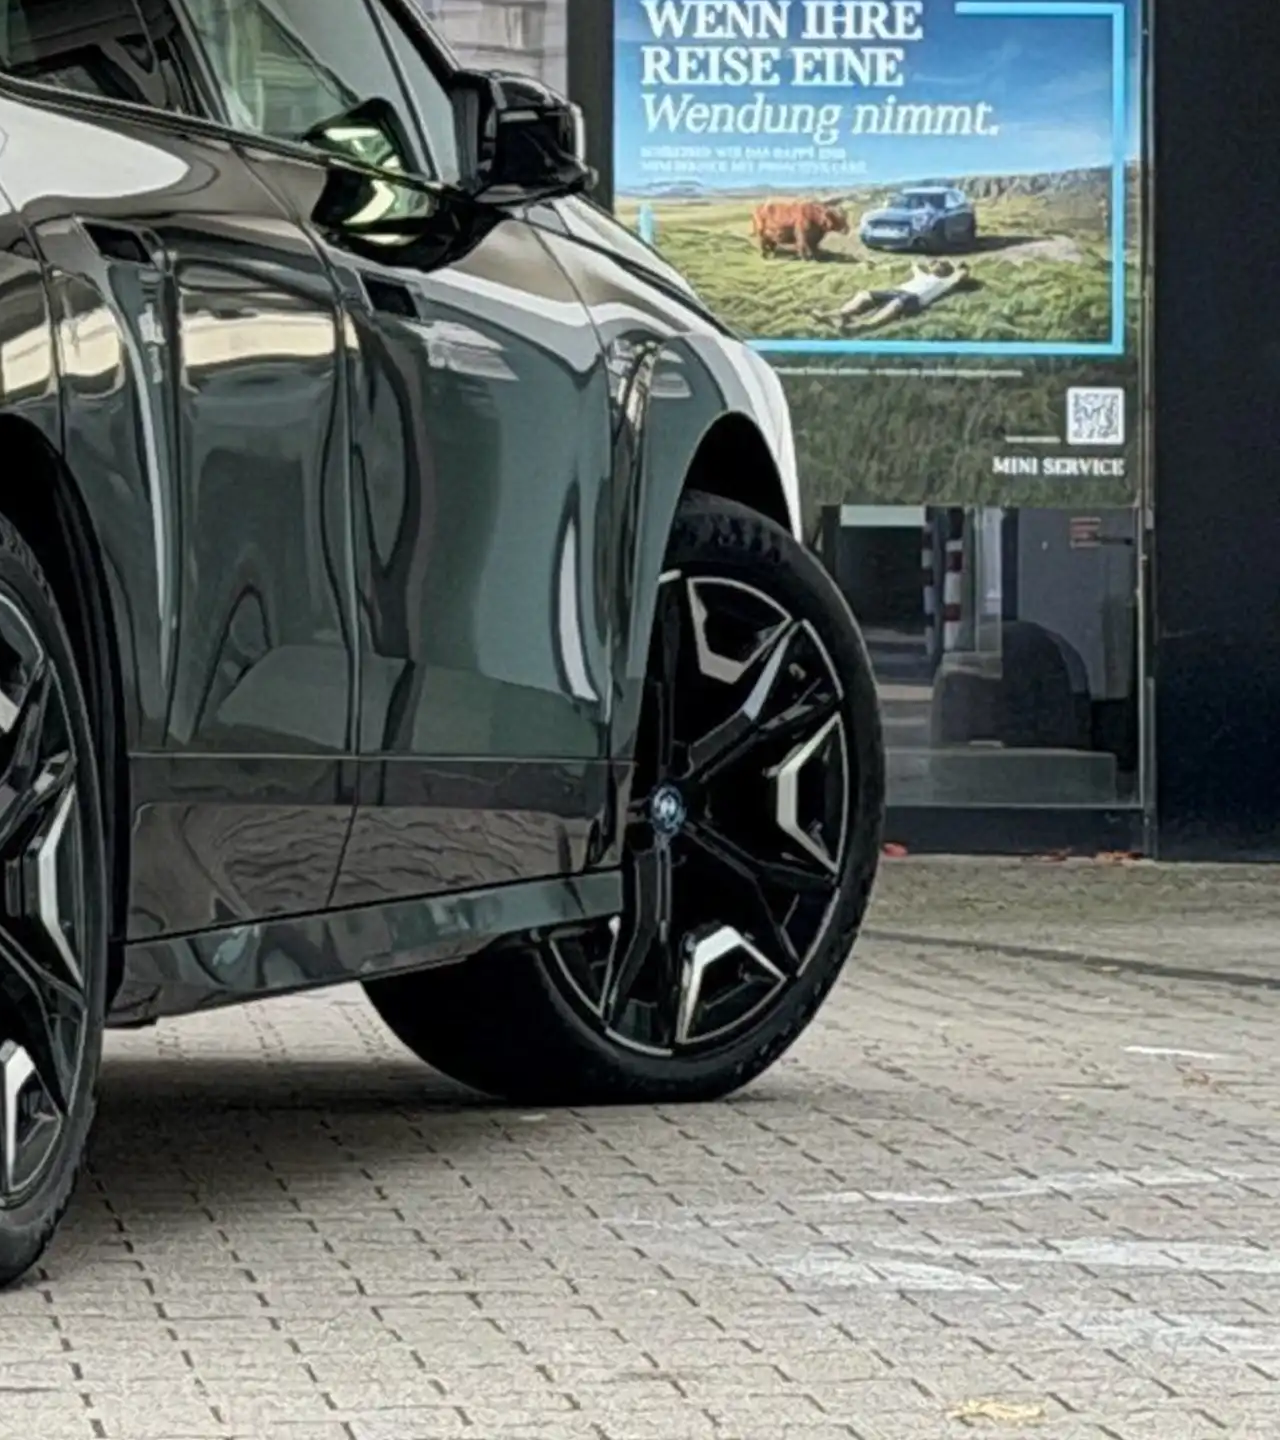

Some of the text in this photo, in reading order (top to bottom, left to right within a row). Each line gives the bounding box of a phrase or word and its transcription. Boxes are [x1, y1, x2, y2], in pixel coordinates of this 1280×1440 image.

[800, 0, 924, 41] IHRE
[640, 45, 905, 88] REISE EINE
[640, 91, 1000, 146] Wendung nimmt.
[992, 457, 1126, 477] MINI SERVICE
